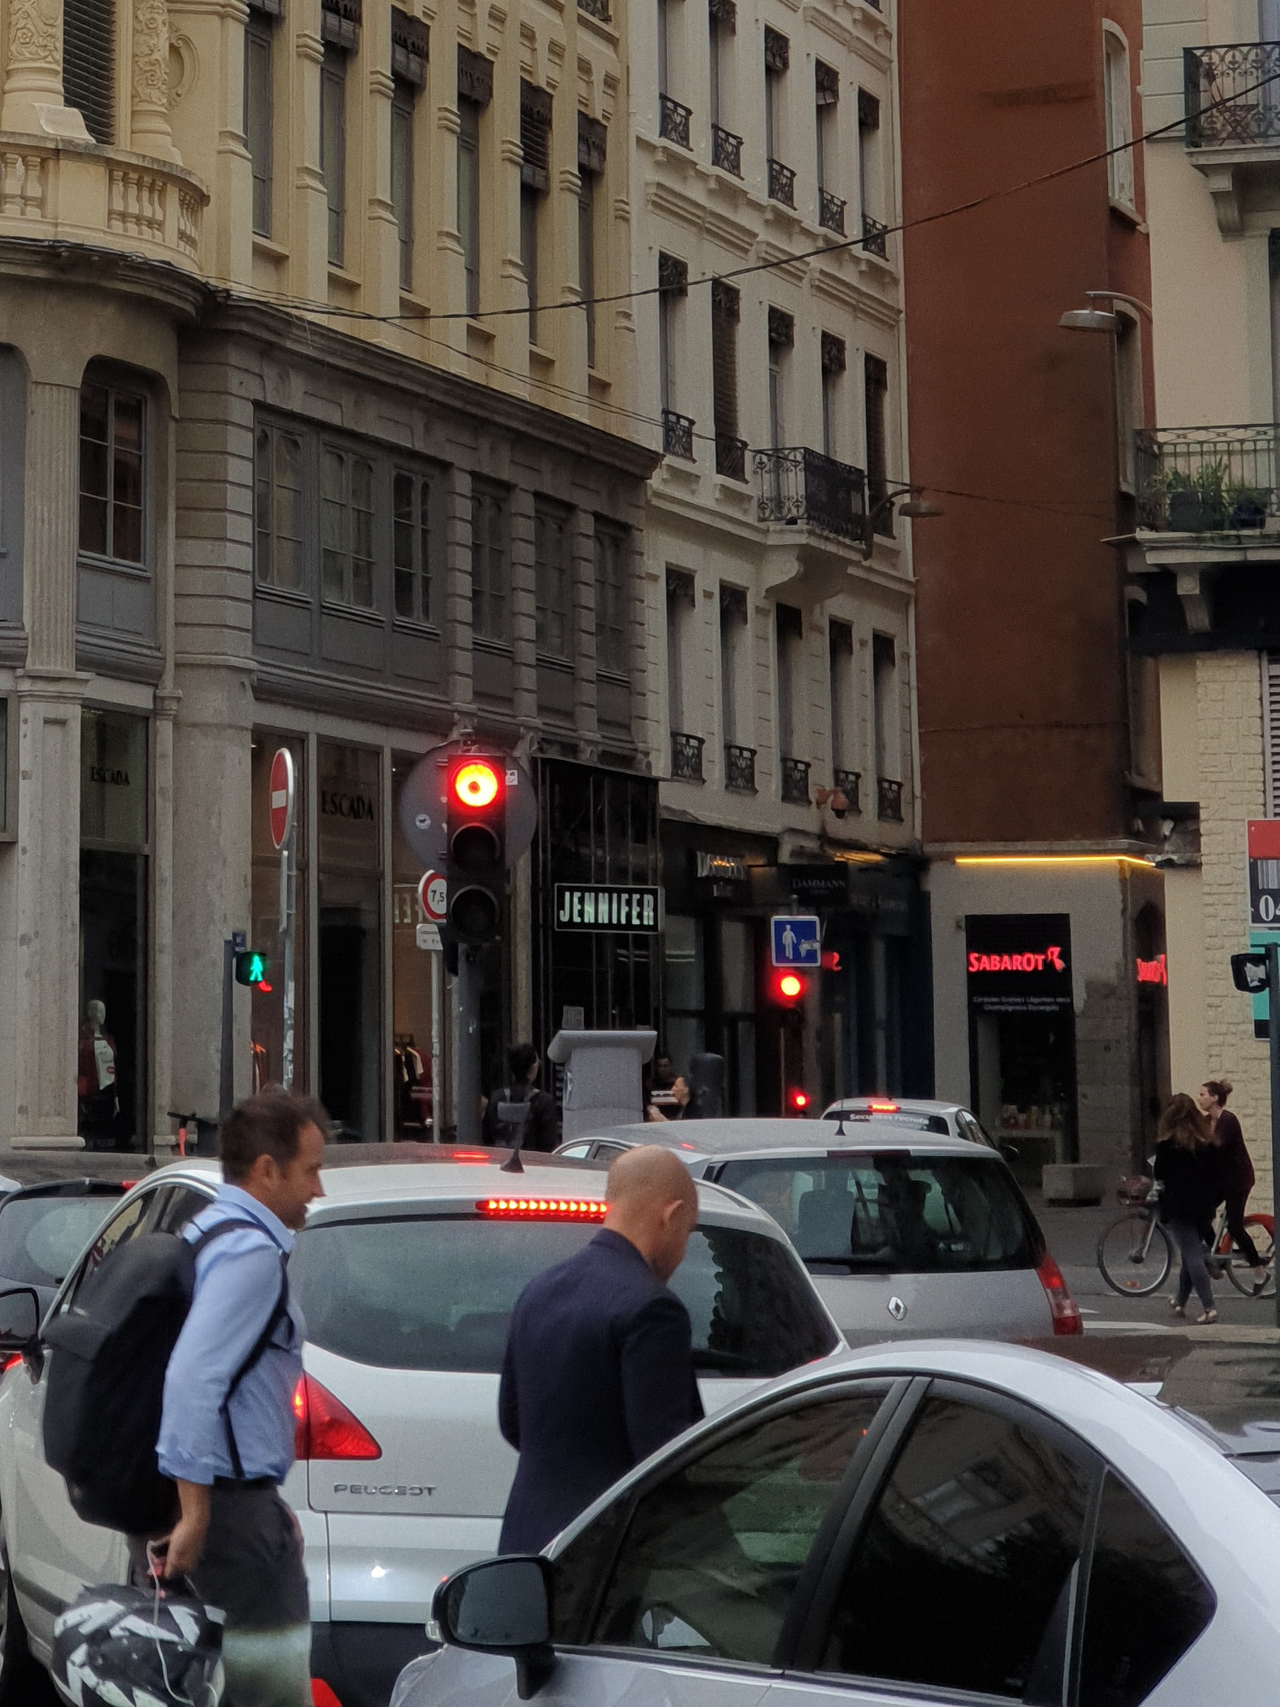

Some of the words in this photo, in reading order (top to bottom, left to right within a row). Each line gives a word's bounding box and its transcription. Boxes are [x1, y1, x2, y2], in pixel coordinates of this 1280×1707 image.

[321, 790, 374, 821] ESCADA
[431, 889, 445, 904] 7,5
[559, 891, 654, 925] JENNIFER
[968, 951, 1046, 973] SABAROT
[333, 1483, 437, 1497] PEUGEOT
